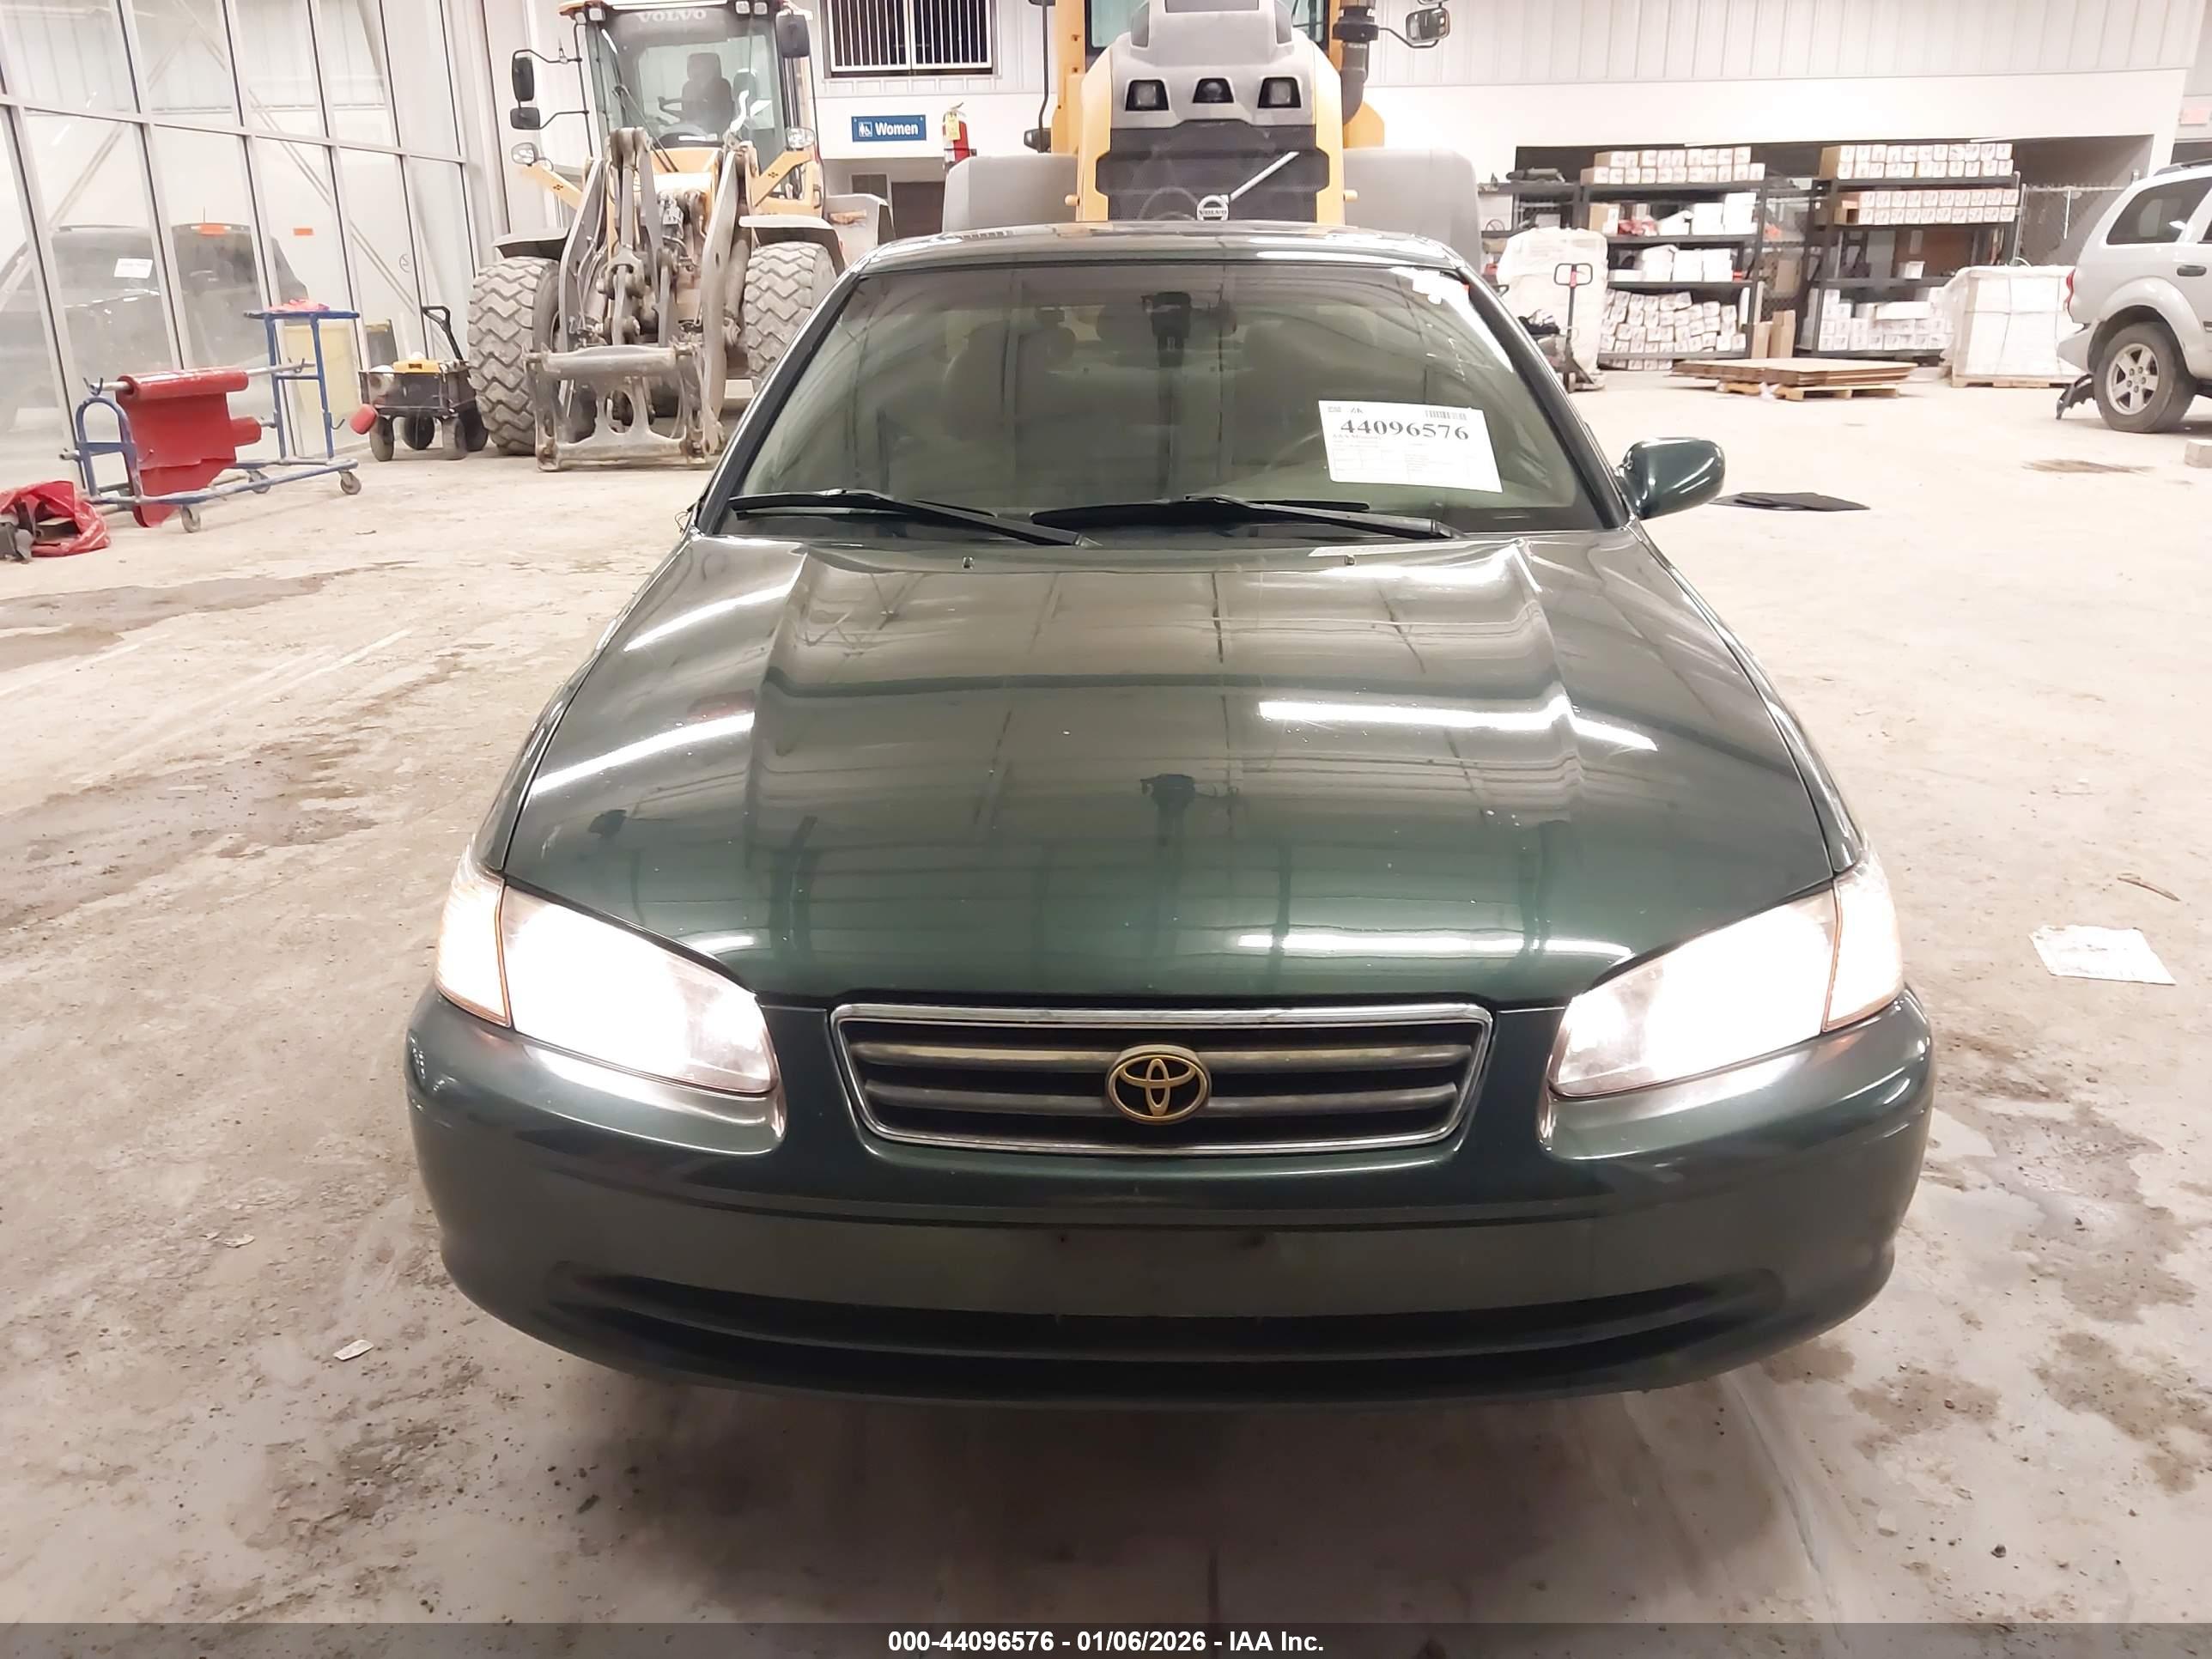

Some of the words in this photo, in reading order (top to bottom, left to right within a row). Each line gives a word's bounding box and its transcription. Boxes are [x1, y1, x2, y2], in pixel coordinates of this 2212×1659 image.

[636, 9, 707, 22] VOLVO
[874, 122, 919, 136] Women
[1340, 419, 1469, 440] 44096576
